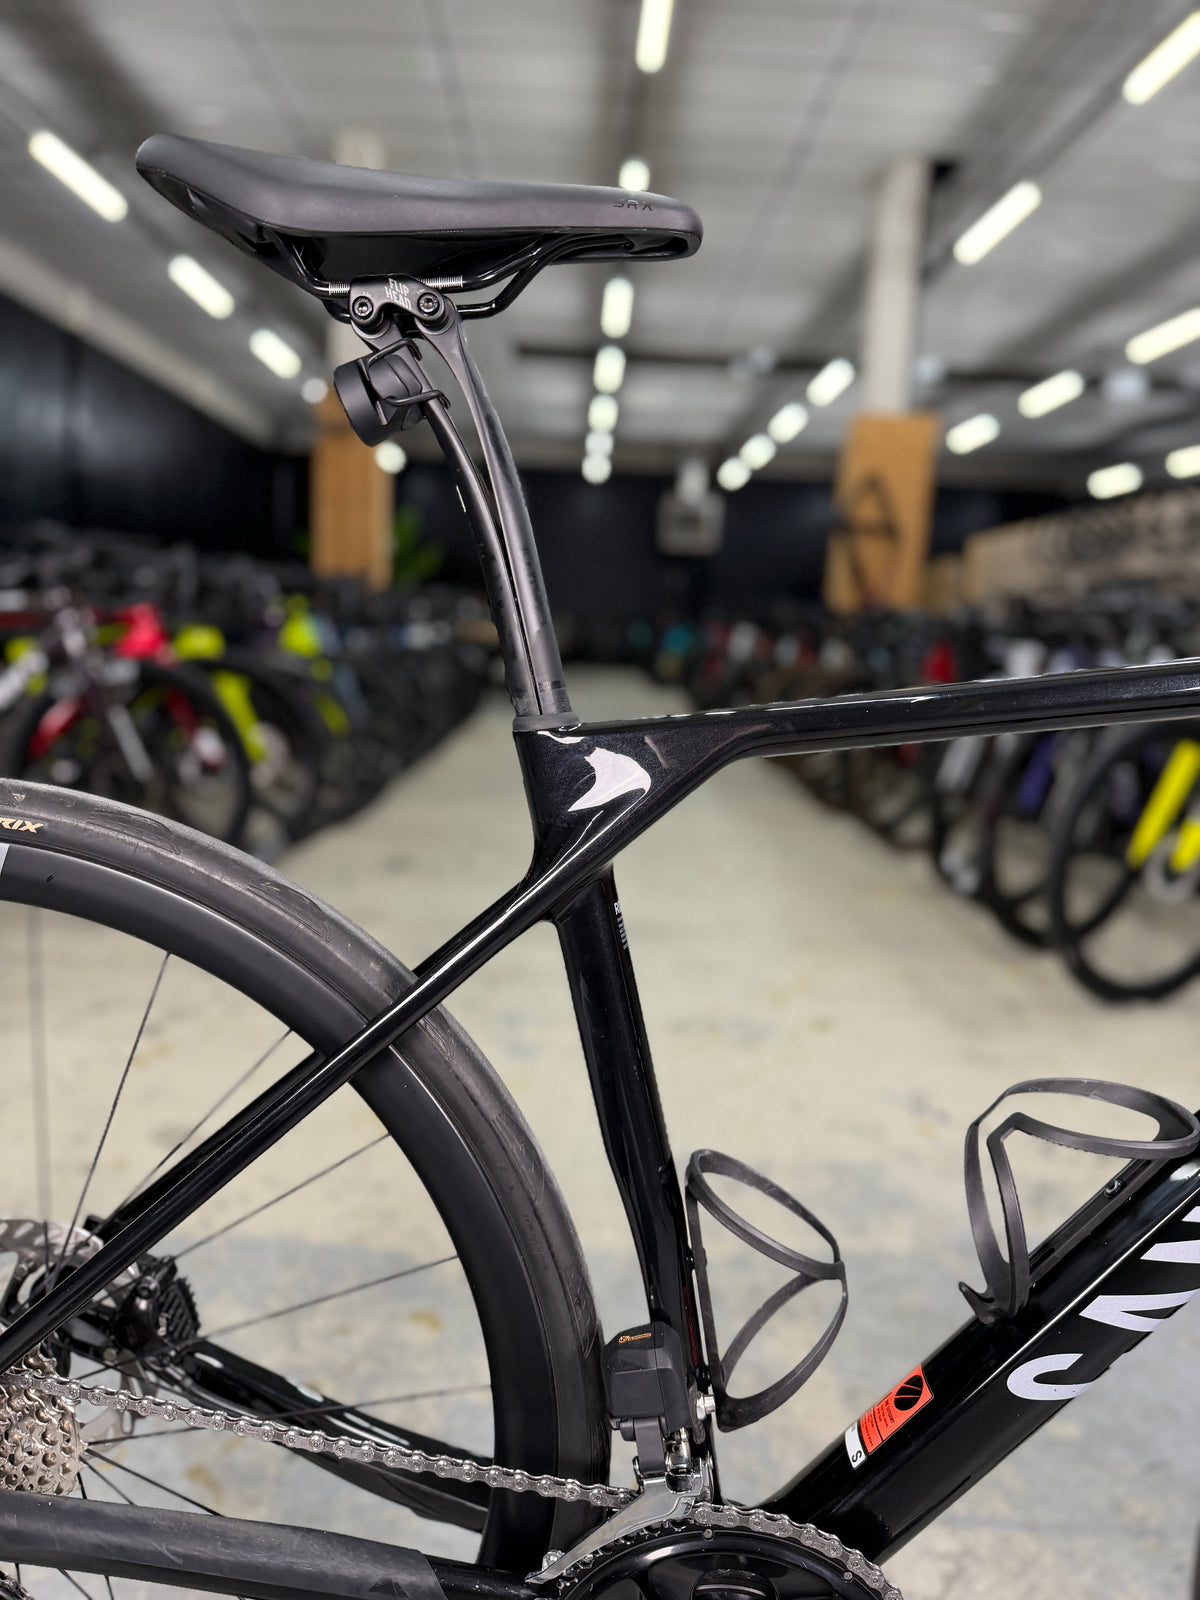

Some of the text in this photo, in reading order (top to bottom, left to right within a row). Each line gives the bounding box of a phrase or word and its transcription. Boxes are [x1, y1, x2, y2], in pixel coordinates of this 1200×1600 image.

[387, 278, 410, 297] FLIP
[384, 286, 412, 310] HEAD
[851, 1450, 862, 1462] S
